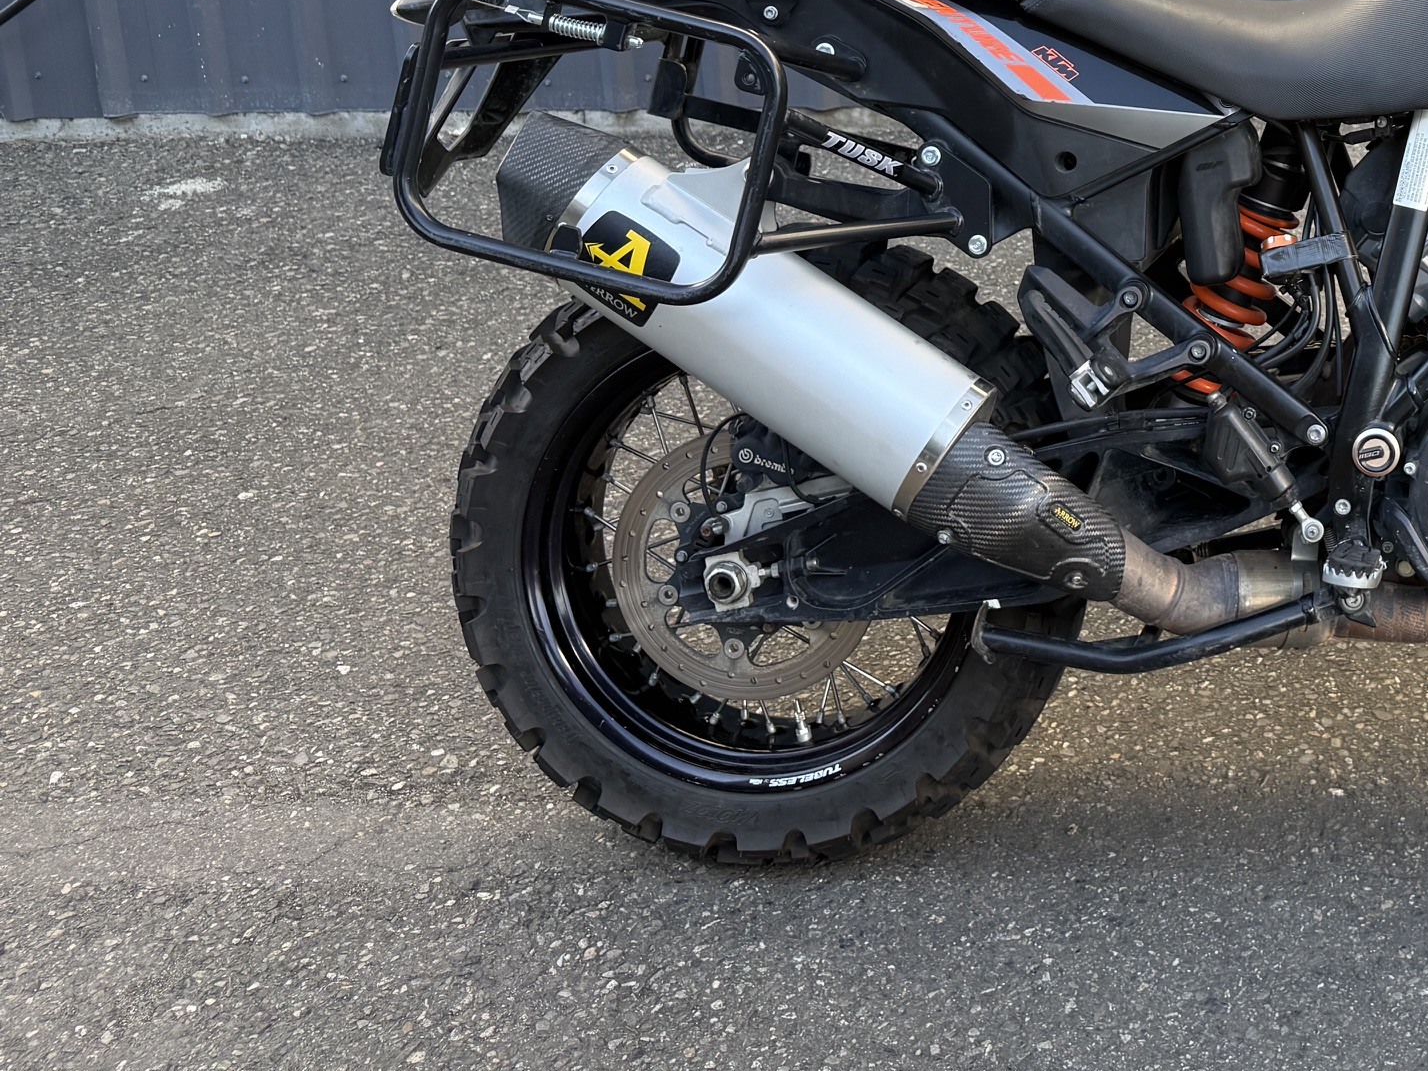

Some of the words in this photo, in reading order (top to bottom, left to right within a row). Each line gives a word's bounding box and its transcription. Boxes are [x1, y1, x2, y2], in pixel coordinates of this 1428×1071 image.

[1031, 46, 1079, 82] KTM
[821, 131, 903, 175] TUSK
[1054, 507, 1081, 528] ARROW
[769, 763, 842, 788] TUBELESS
